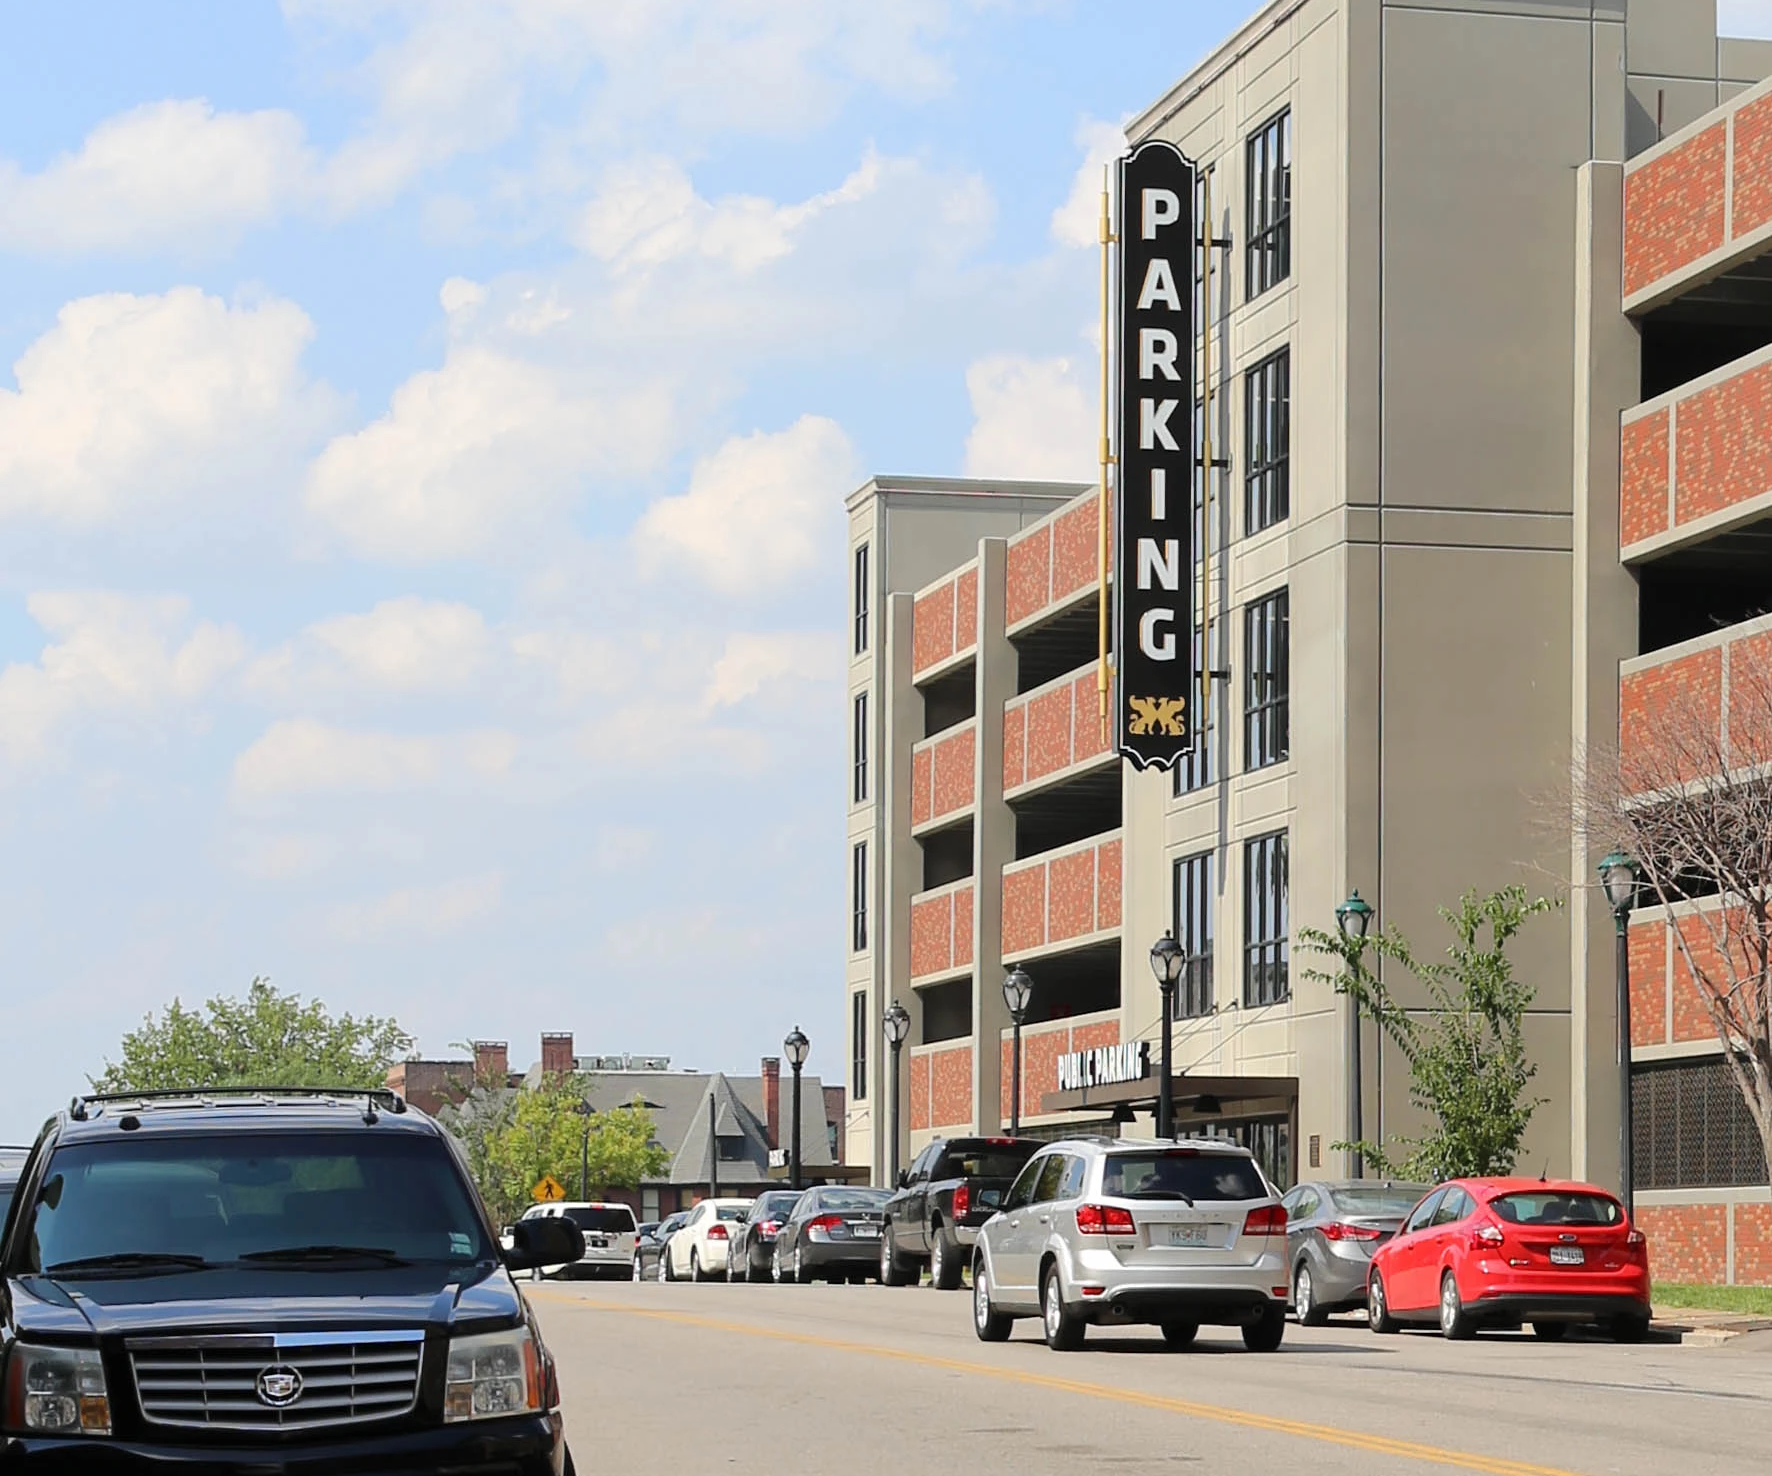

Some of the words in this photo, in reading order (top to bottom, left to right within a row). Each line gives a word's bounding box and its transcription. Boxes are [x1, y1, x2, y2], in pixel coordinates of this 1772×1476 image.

[1137, 187, 1182, 662] PARKING
[1057, 1049, 1093, 1091] PUBLIC
[1095, 1041, 1143, 1085] PARKING
